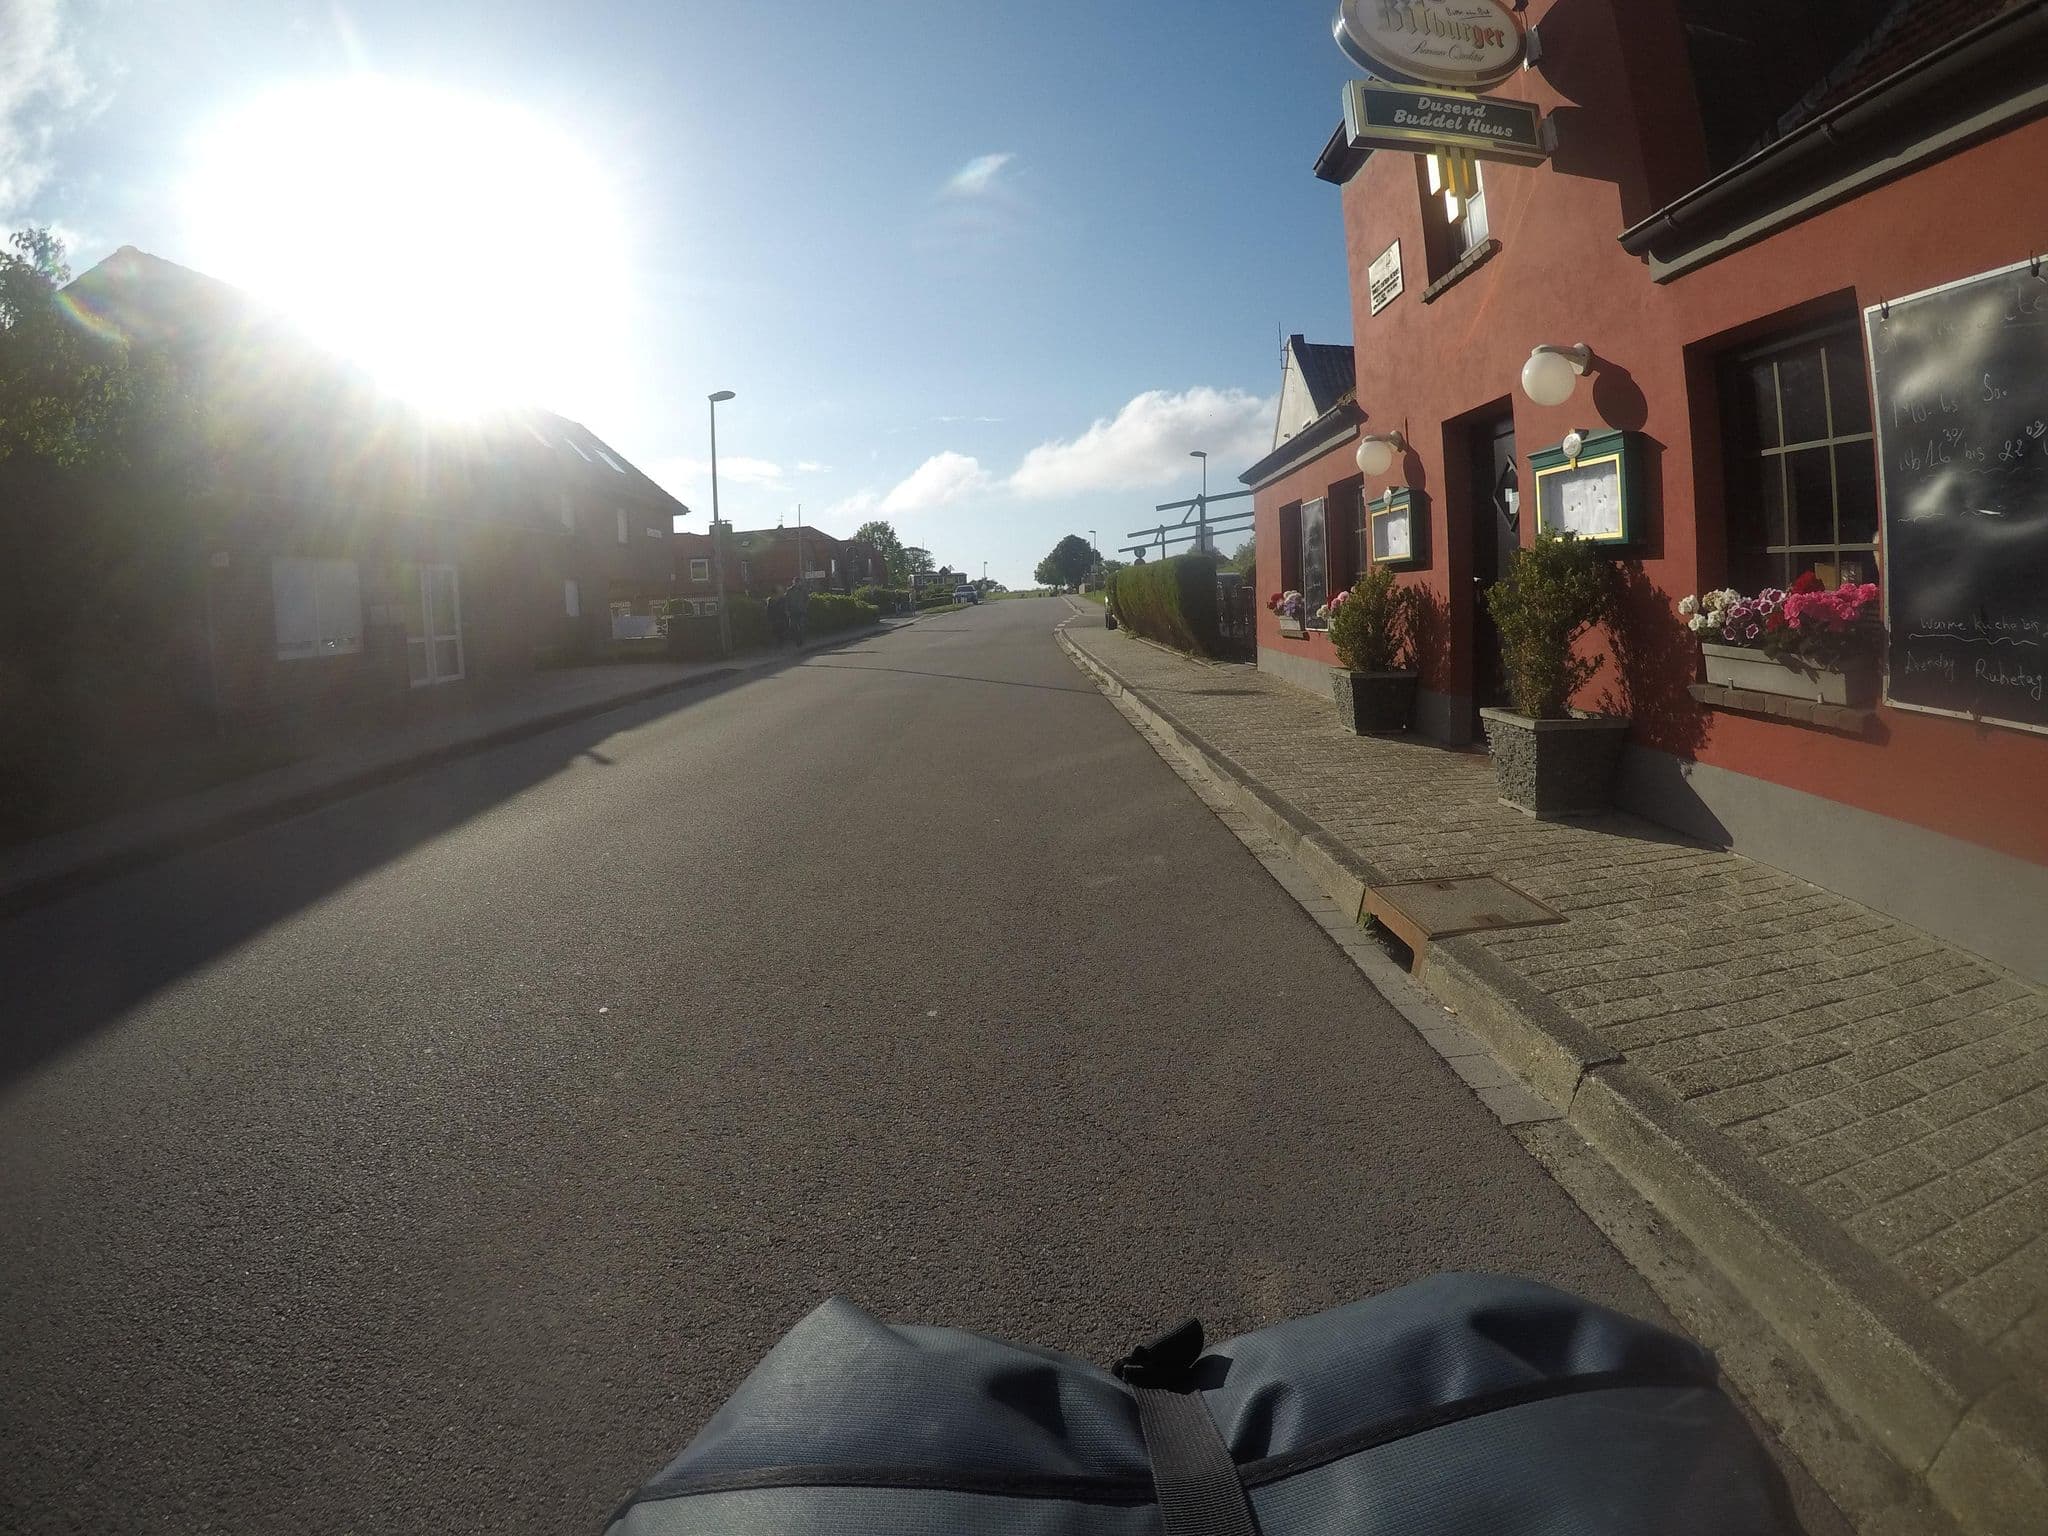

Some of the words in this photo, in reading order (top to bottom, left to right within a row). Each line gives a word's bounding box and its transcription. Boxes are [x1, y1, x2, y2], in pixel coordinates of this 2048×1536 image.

[1418, 97, 1486, 118] Dusend
[1393, 109, 1462, 130] Buddel
[1467, 118, 1513, 137] Huus
